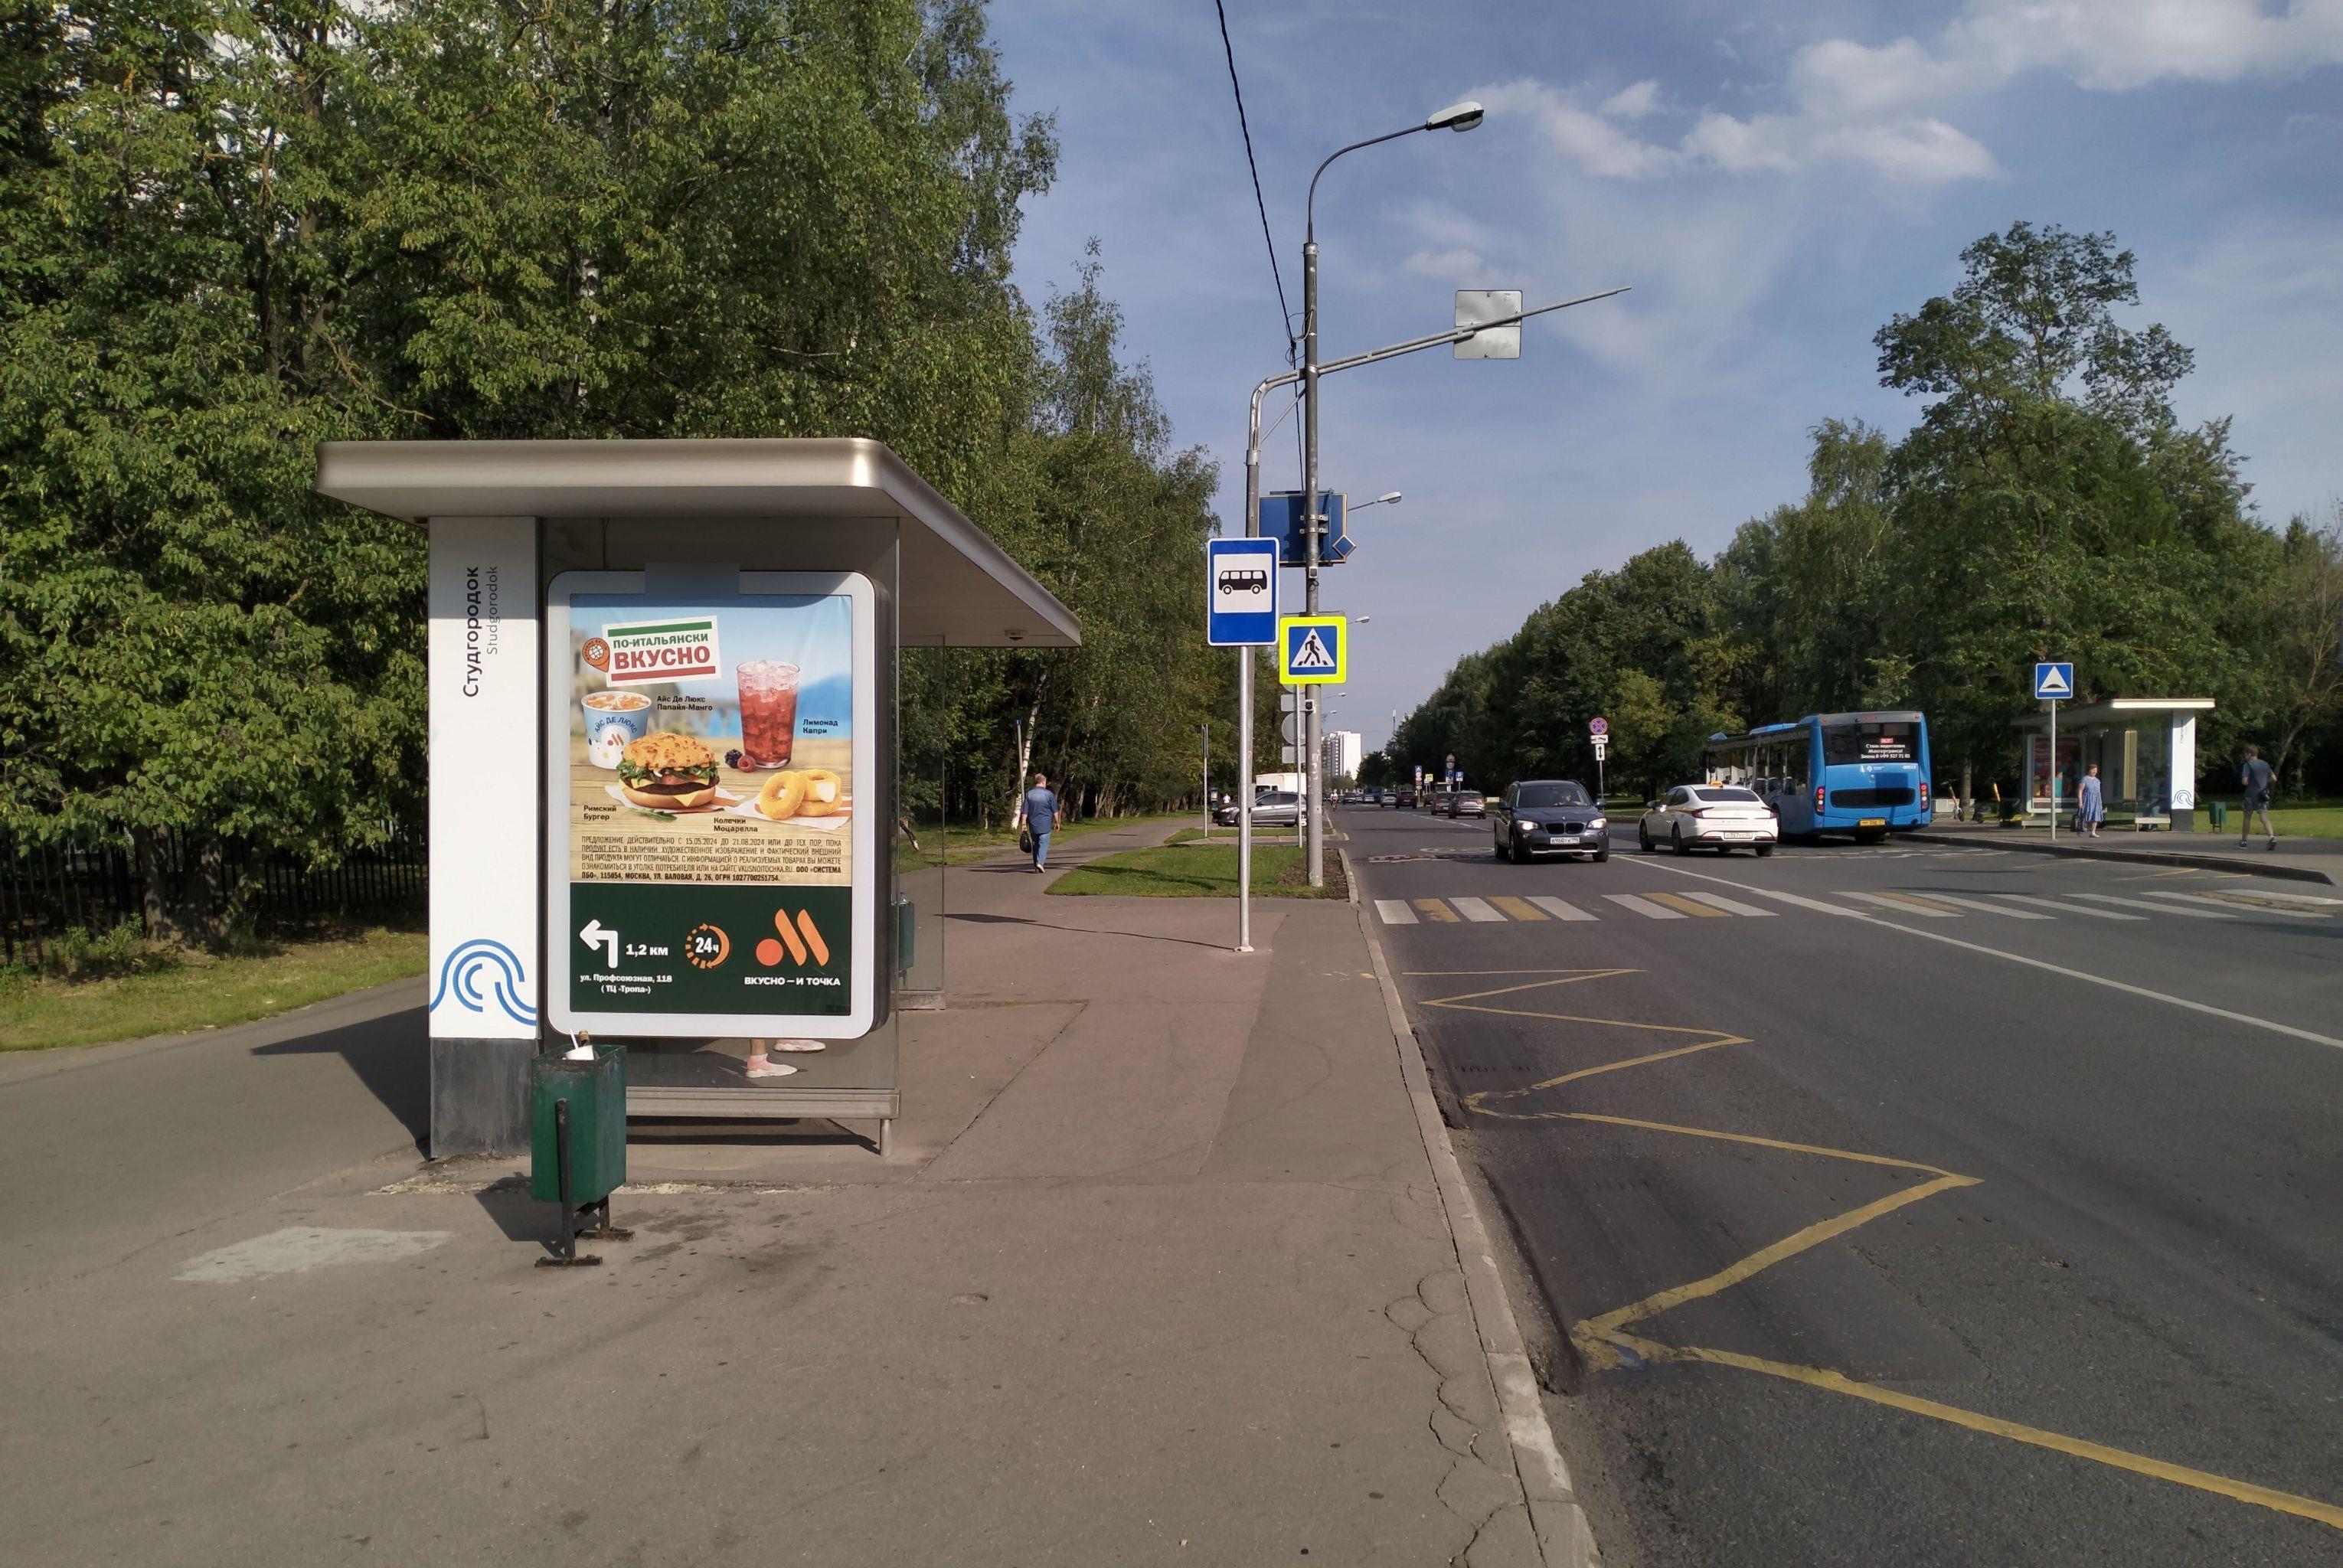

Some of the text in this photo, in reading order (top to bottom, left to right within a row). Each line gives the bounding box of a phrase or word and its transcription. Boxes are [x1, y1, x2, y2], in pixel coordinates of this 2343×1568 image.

[486, 566, 500, 655] Studgorodok
[462, 567, 482, 697] Студгородок
[613, 633, 708, 649] ПО-ИТАЛЬЯНСКИ
[615, 645, 711, 669] ВКУСНО
[594, 716, 639, 734] АЙС ДЕ ЛЮКС
[583, 813, 610, 822] Бургер
[627, 835, 675, 844] ДЕЙСТВИТЕЛЬНО
[766, 847, 809, 855] ФАКТИЧЕСКИЙ
[626, 944, 668, 957] 1,2 км
[695, 936, 719, 954] 24ч
[580, 974, 672, 984] ул. Профсоюзная, 118
[744, 977, 786, 986] ВКУСНО
[796, 978, 804, 986] И
[806, 978, 841, 986] ТОЧКА
